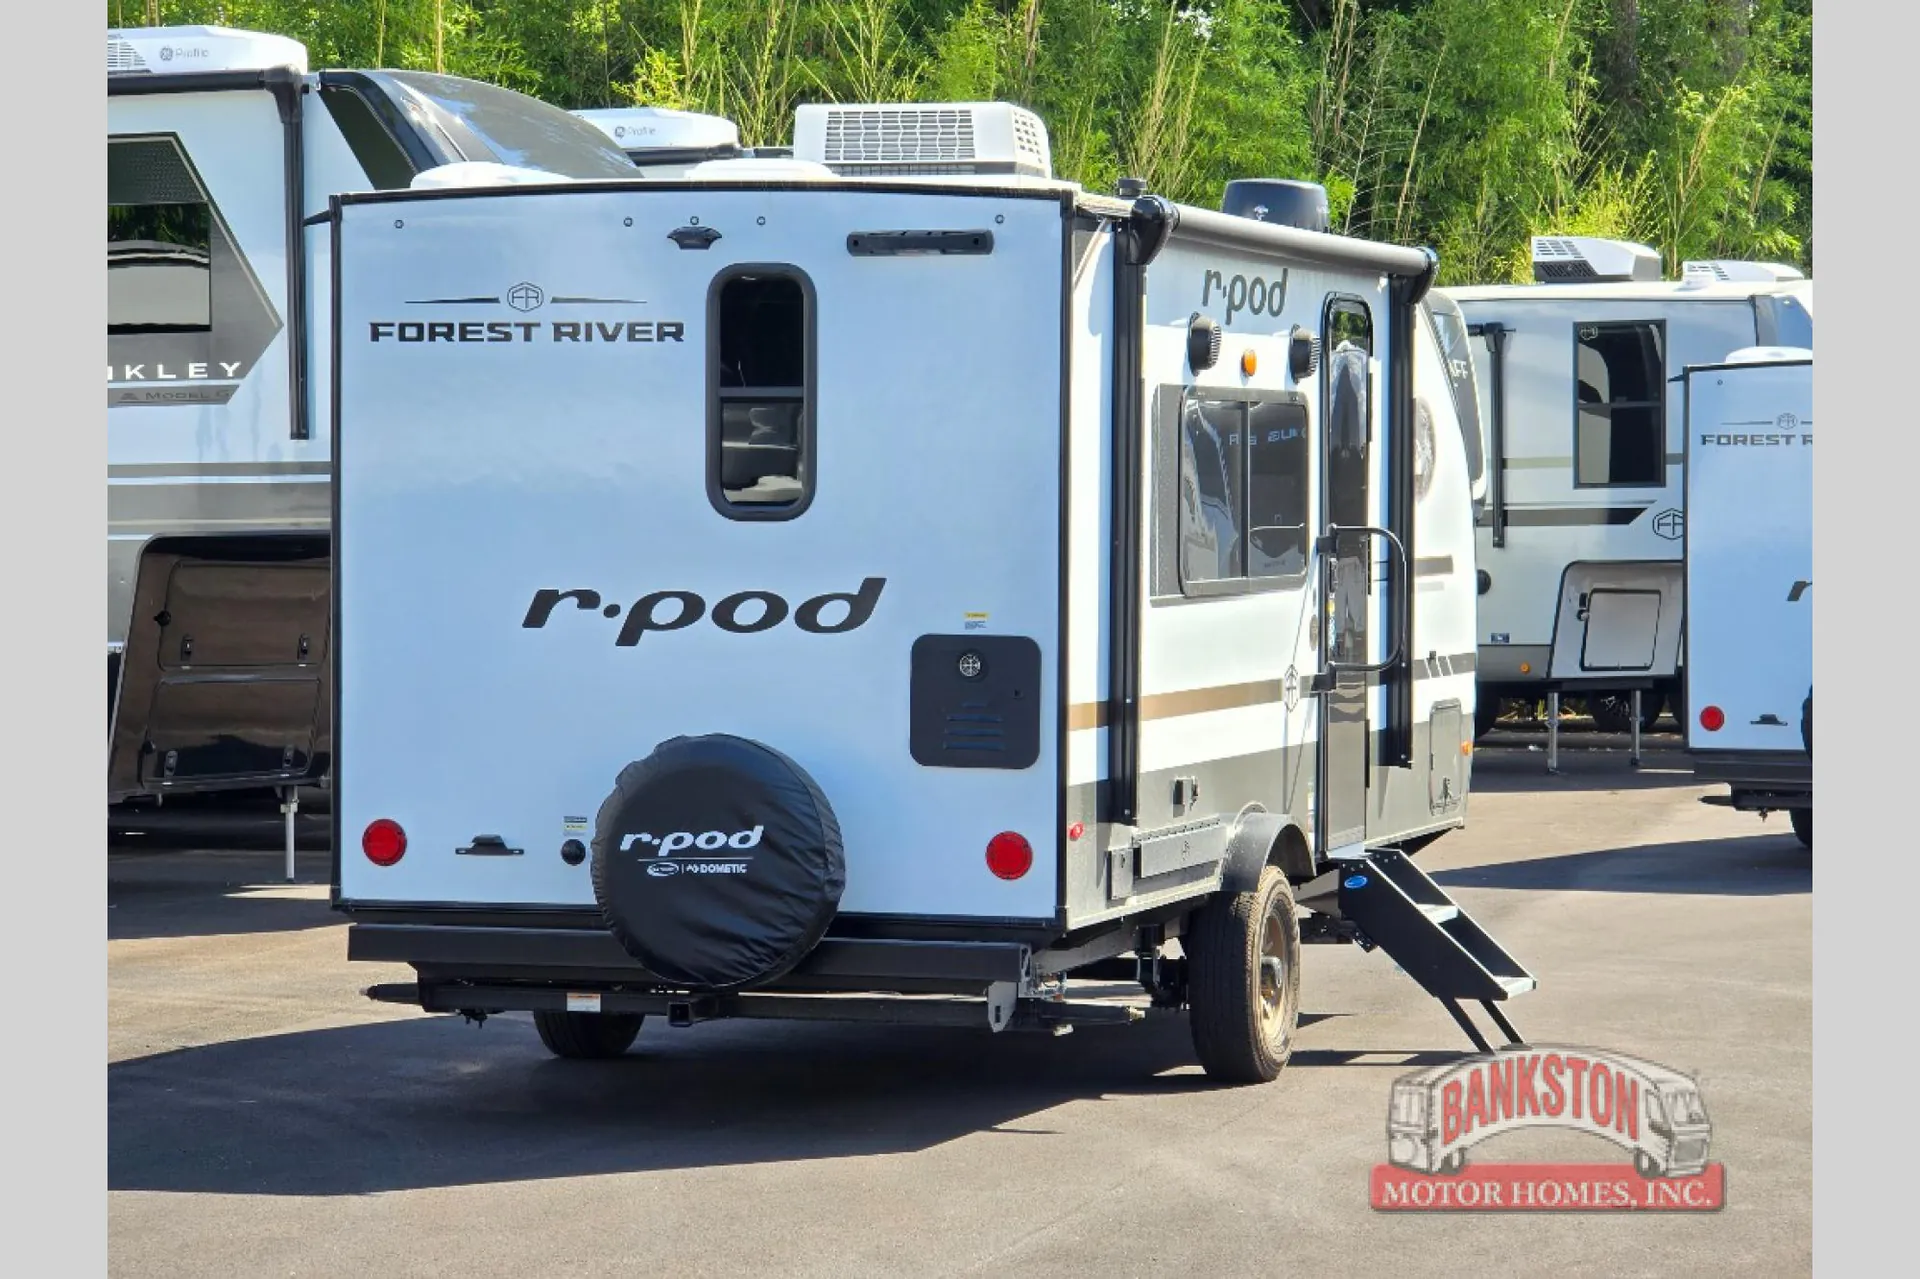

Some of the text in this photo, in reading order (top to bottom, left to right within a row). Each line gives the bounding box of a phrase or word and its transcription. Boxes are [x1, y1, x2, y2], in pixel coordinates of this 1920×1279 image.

[369, 322, 685, 342] FOREST RIVER
[1700, 434, 1796, 446] FOREST
[700, 863, 748, 874] DOMETIC
